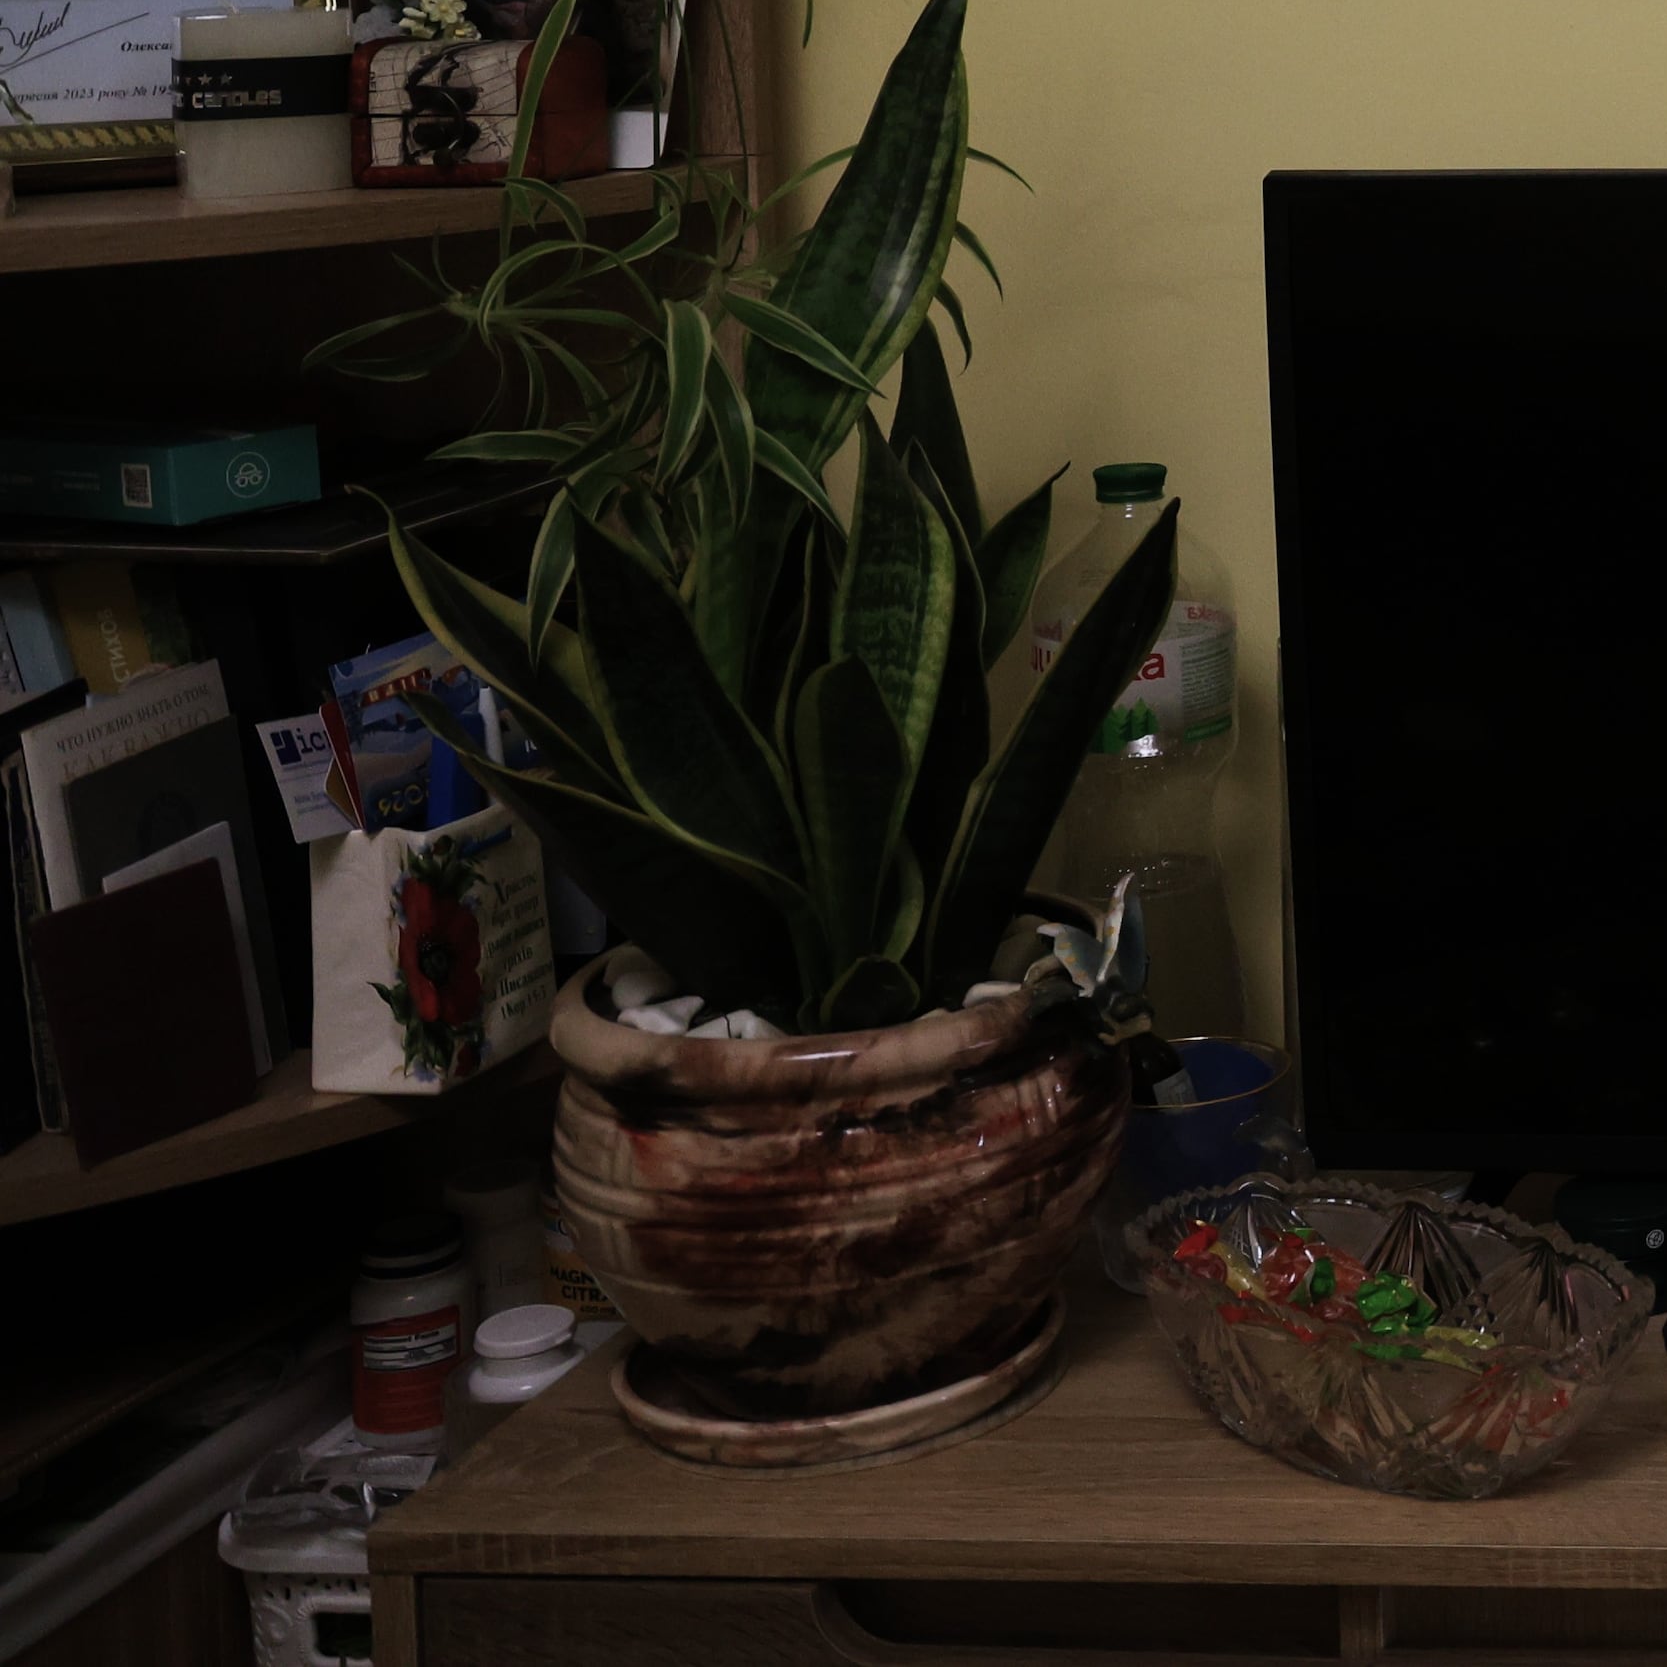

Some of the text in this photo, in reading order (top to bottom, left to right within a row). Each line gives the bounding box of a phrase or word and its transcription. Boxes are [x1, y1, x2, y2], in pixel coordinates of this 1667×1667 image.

[120, 41, 173, 53] Олекса
[15, 92, 58, 104] ересня
[63, 88, 94, 100] 2023
[97, 90, 126, 103] року
[56, 734, 84, 754] ЧТО
[85, 715, 135, 744] НУЖНО
[135, 697, 172, 723] ЗНАТЬ
[549, 1265, 595, 1285] MAGN
